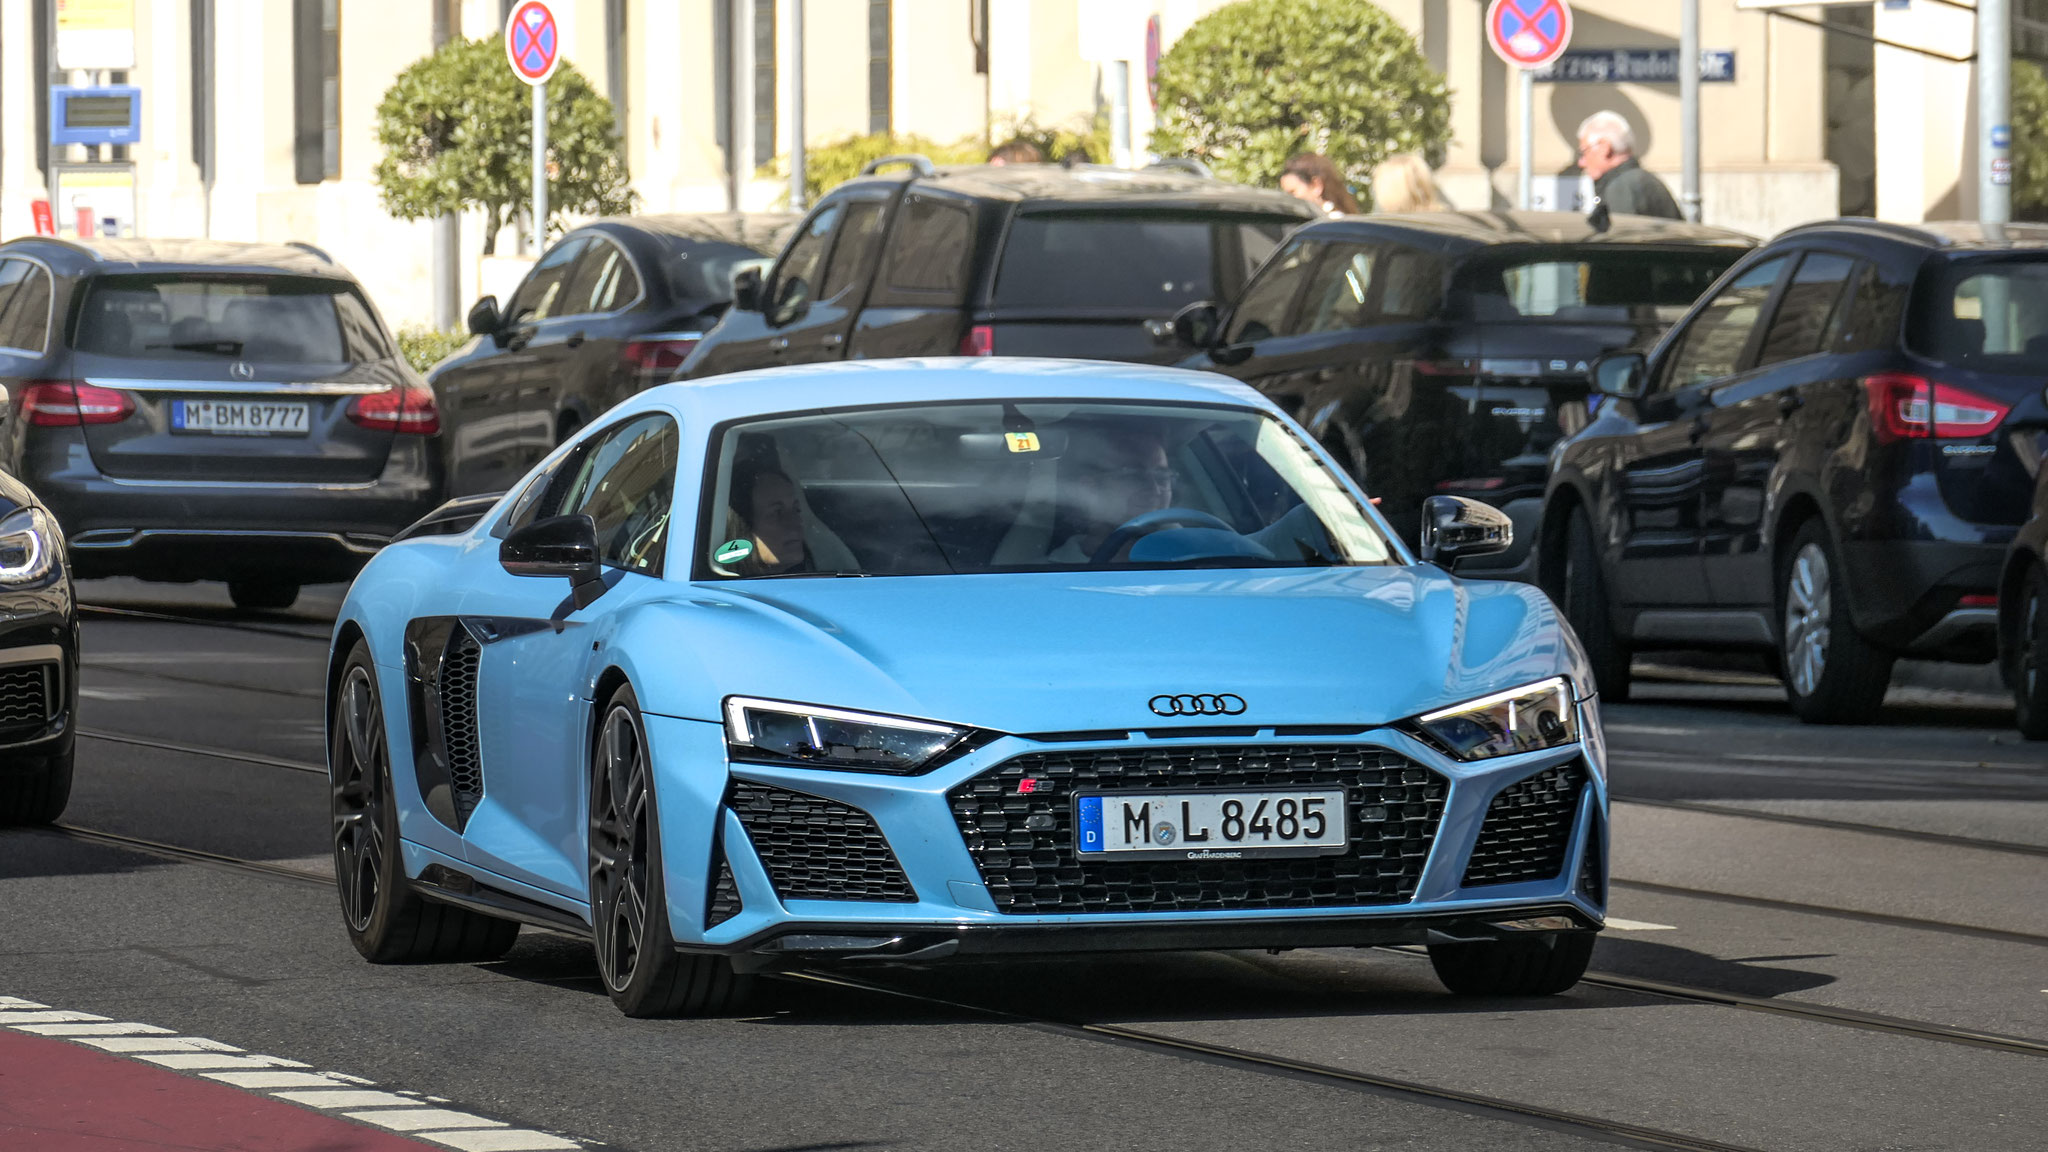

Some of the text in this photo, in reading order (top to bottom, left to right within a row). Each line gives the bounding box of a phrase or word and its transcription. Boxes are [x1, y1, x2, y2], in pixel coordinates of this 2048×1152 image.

[186, 404, 200, 425] M
[216, 405, 244, 426] BM
[250, 405, 304, 427] 8777
[1123, 798, 1326, 844] M L 8485
[1086, 831, 1096, 843] D
